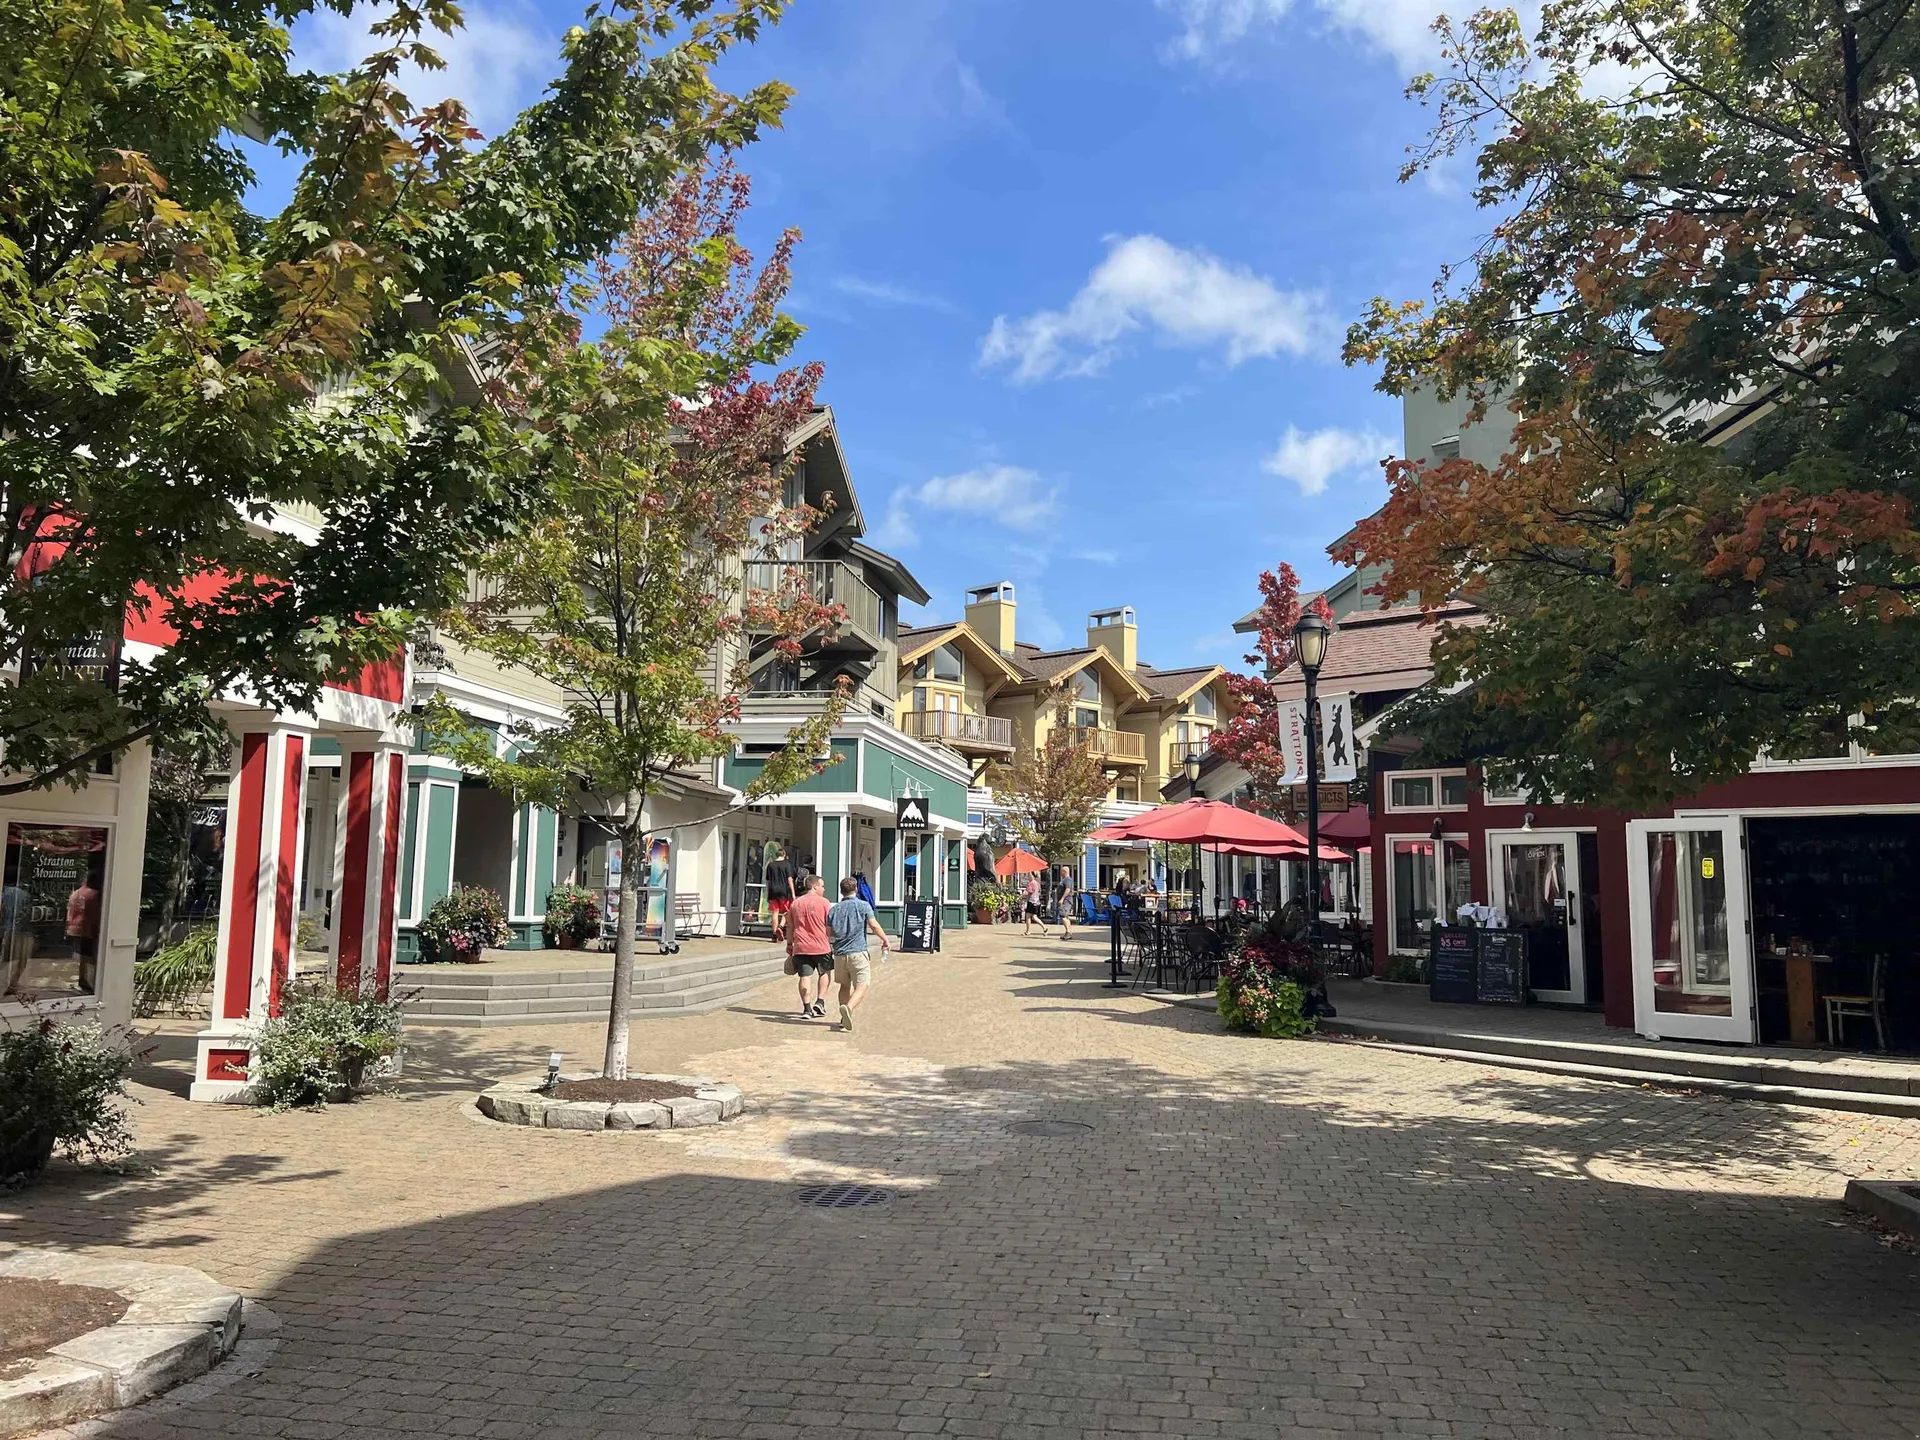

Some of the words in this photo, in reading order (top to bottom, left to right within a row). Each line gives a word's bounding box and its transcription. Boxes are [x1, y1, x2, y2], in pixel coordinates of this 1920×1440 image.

[1290, 707, 1304, 765] STRATTON
[1296, 791, 1345, 804] BEDICTS
[37, 854, 75, 866] Stratton
[1527, 850, 1545, 859] OPEN
[32, 867, 77, 879] Mountain
[32, 880, 77, 893] MARKET
[922, 905, 934, 948] SIDEWAYS
